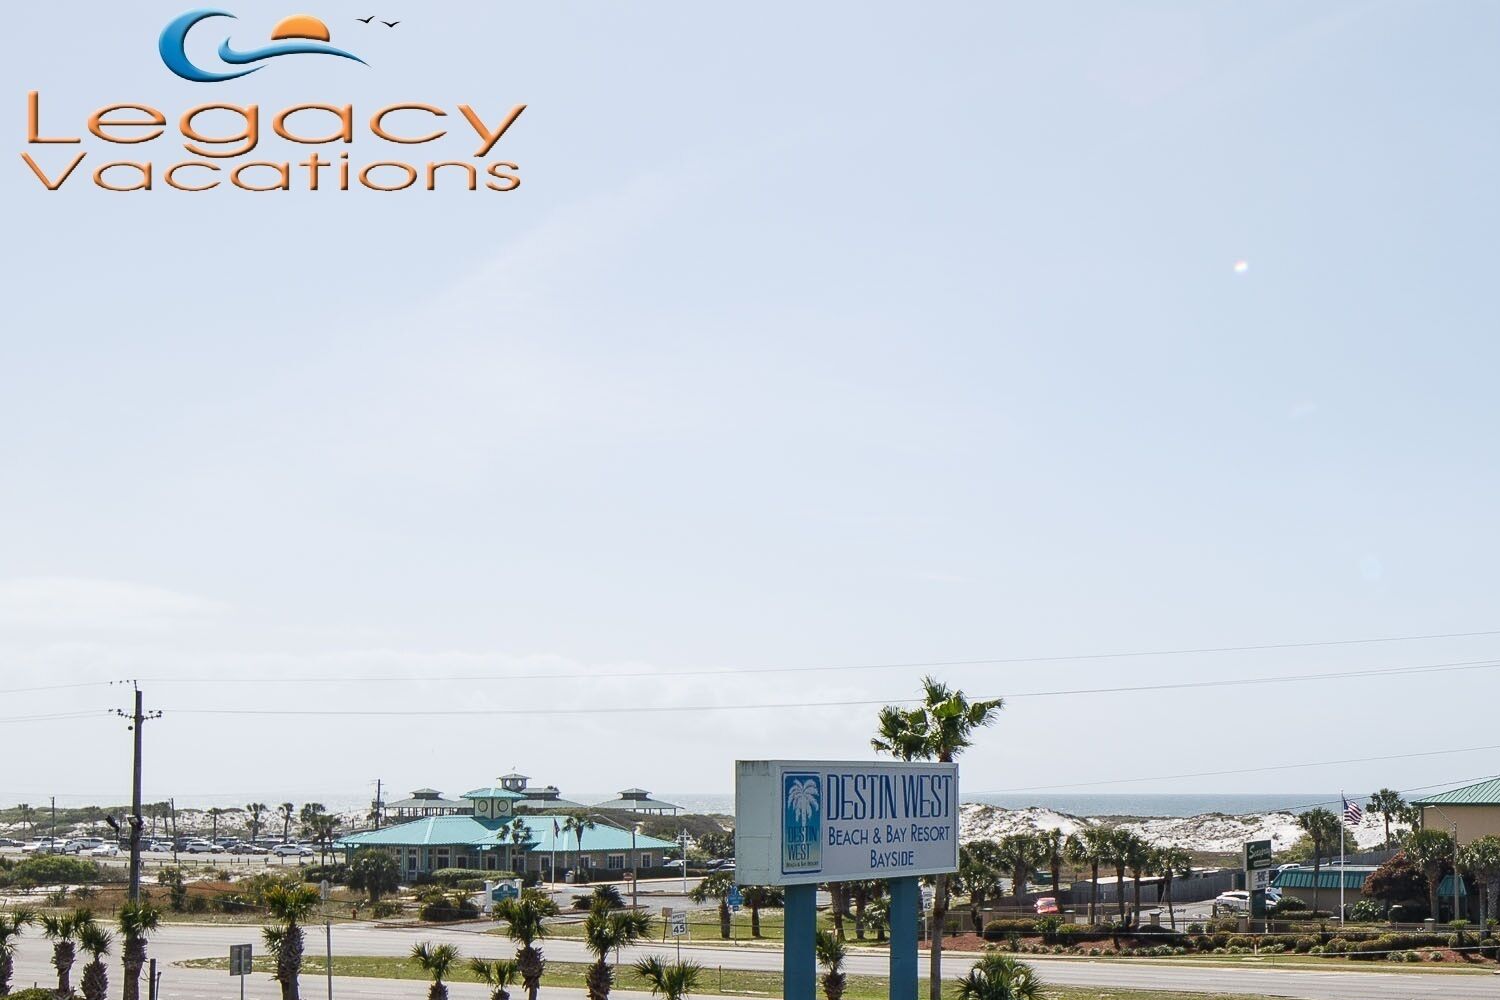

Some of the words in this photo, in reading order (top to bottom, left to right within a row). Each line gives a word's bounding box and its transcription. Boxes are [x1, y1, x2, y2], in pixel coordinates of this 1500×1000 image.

[827, 774, 897, 820] DESTIN
[902, 774, 953, 818] WEST
[788, 826, 817, 843] DESTIN
[828, 826, 868, 846] BEACH
[872, 827, 882, 844] &
[886, 824, 907, 843] BAY
[911, 823, 950, 842] RESORT
[788, 843, 811, 860] WEST
[870, 849, 914, 868] BAYSIDE
[673, 924, 685, 934] 45
